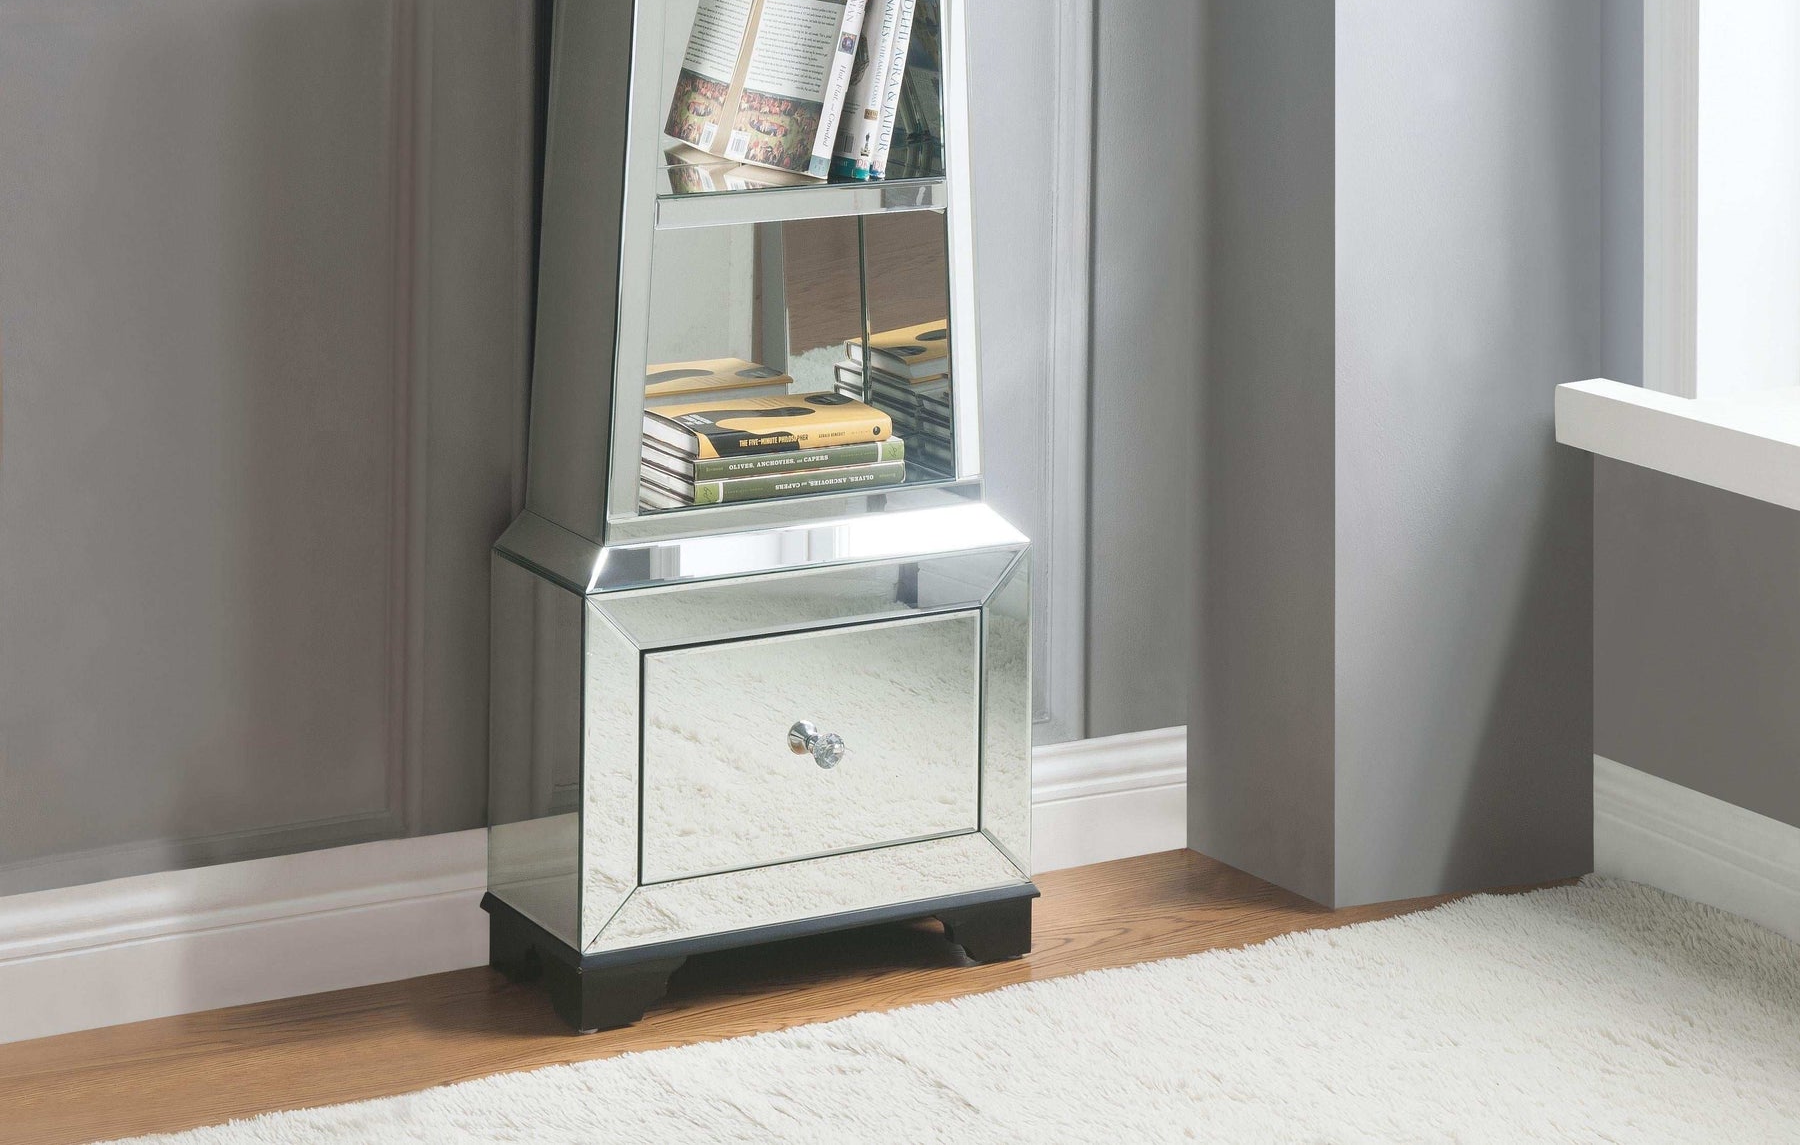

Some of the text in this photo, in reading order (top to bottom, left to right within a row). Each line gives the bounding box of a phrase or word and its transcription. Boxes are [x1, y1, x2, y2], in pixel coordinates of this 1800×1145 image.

[878, 0, 914, 152] DELHI, AGRA & JAIPUR
[822, 113, 836, 147] Crowded
[739, 434, 809, 447] THE FIVE-MINUTE PHILOSOPHER
[728, 463, 755, 471] OLIVES,
[756, 458, 795, 468] ANCHOVIES,
[803, 455, 829, 463] CAPERS
[808, 477, 847, 486] ANCHOVIES,
[849, 474, 874, 482] OLIVES,
[775, 482, 800, 490] CAPERS
